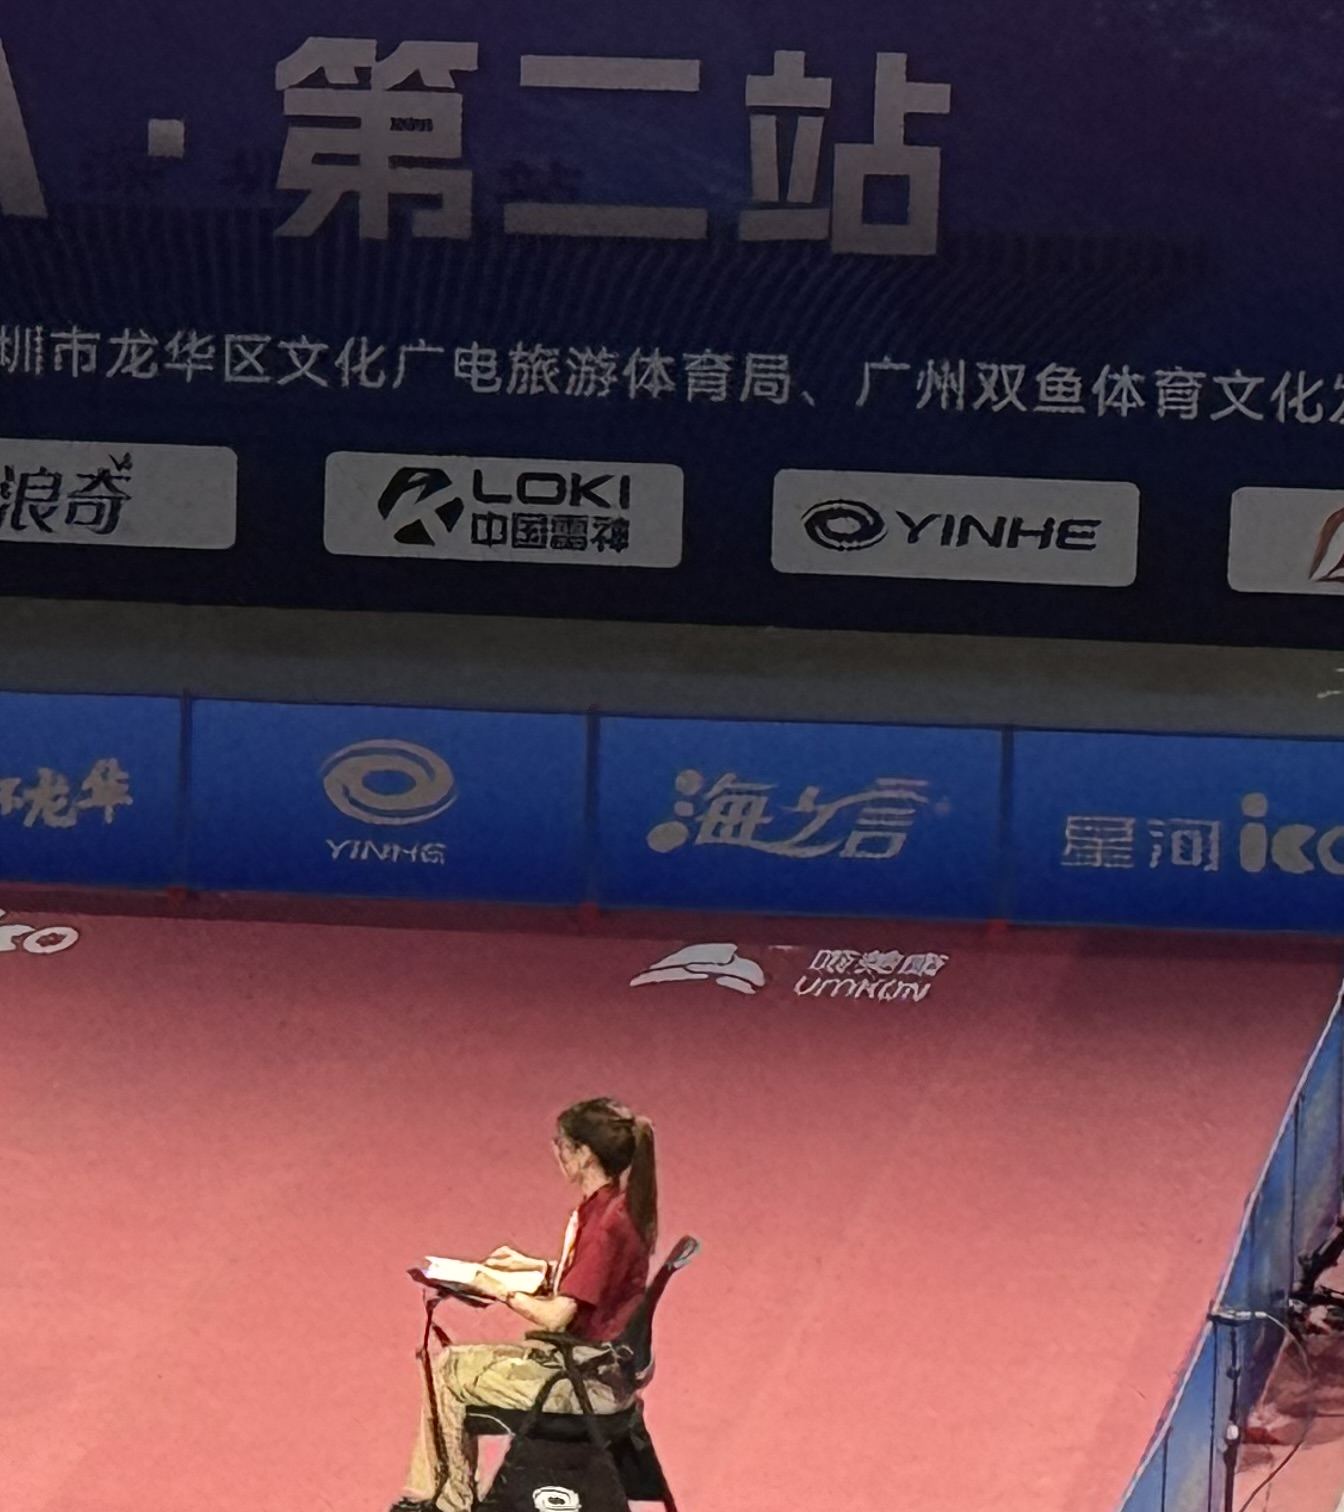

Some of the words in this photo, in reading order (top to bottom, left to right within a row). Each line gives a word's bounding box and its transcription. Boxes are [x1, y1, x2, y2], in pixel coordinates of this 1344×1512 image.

[471, 470, 632, 511] LOKI
[470, 512, 631, 555] 中国雷神
[897, 509, 1103, 552] YINHE
